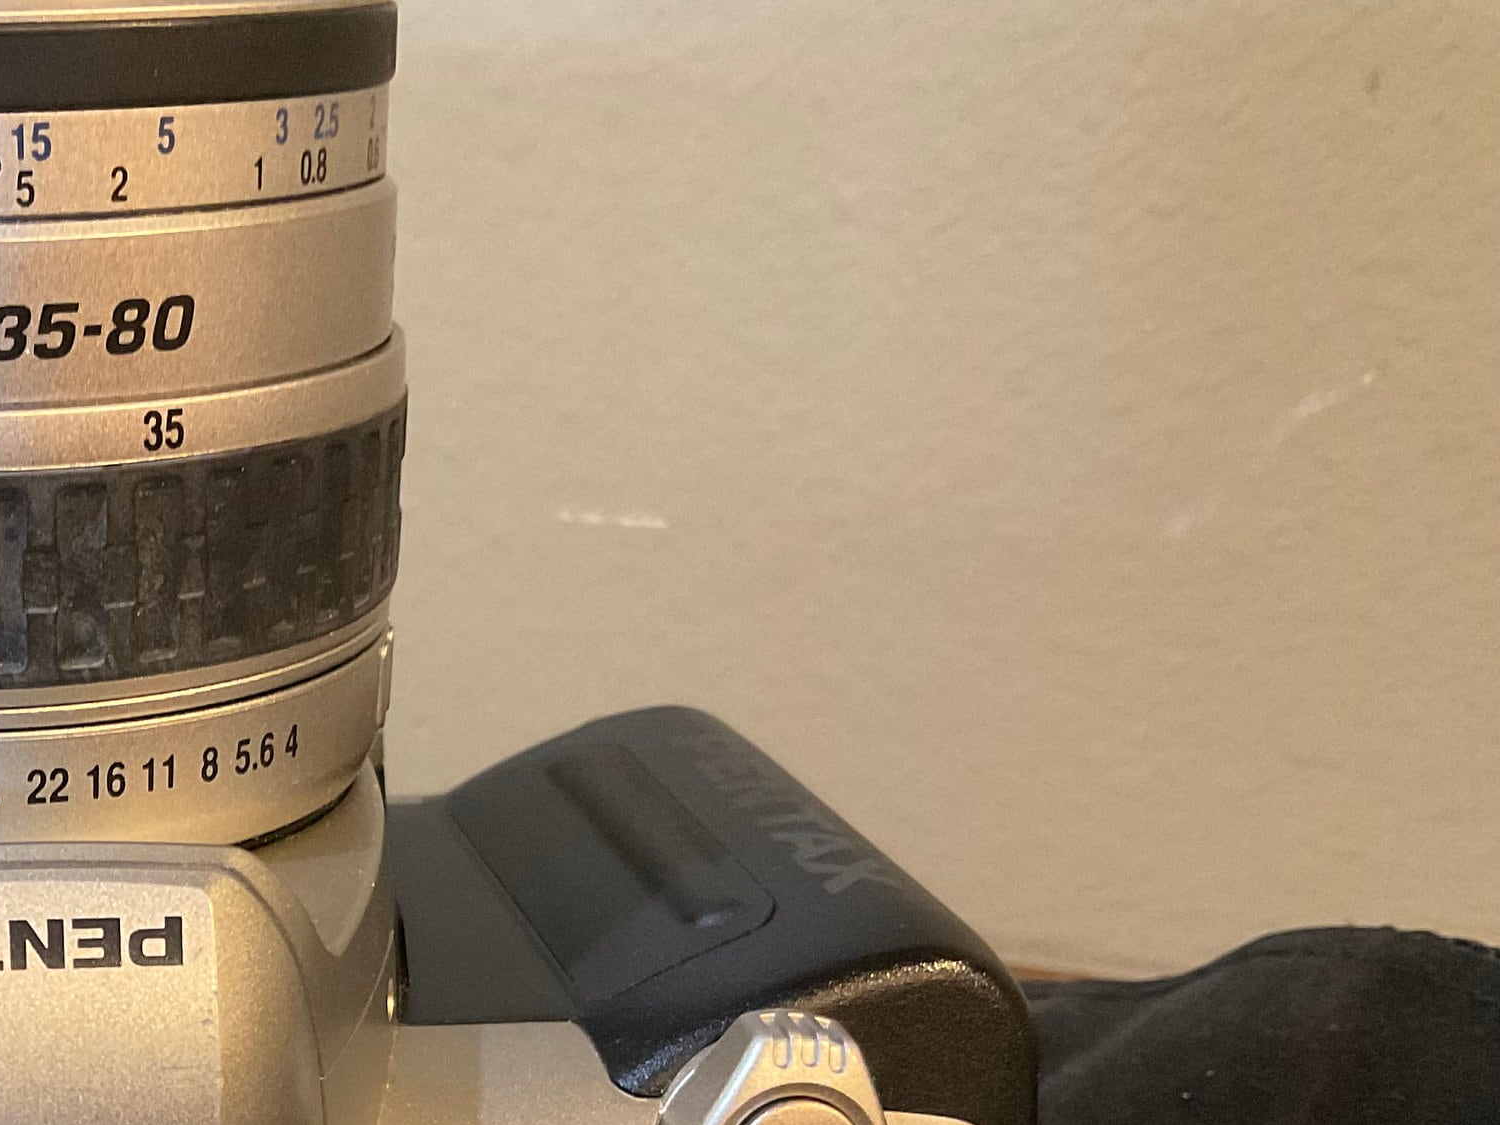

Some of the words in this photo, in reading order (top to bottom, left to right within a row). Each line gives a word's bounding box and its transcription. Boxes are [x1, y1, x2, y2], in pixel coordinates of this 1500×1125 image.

[11, 121, 51, 161] 15
[157, 116, 176, 155] 5
[275, 107, 289, 145] 3
[314, 101, 339, 140] 2.5
[16, 170, 35, 207] 5
[110, 166, 128, 202] 2
[254, 154, 263, 191] 1
[300, 147, 327, 186] 0.8
[143, 408, 184, 451] 35
[27, 768, 69, 804] 22
[86, 762, 126, 799] 16
[142, 754, 175, 792] 11
[201, 747, 218, 782] 8
[235, 732, 274, 774] 5.6
[285, 724, 298, 757] 4
